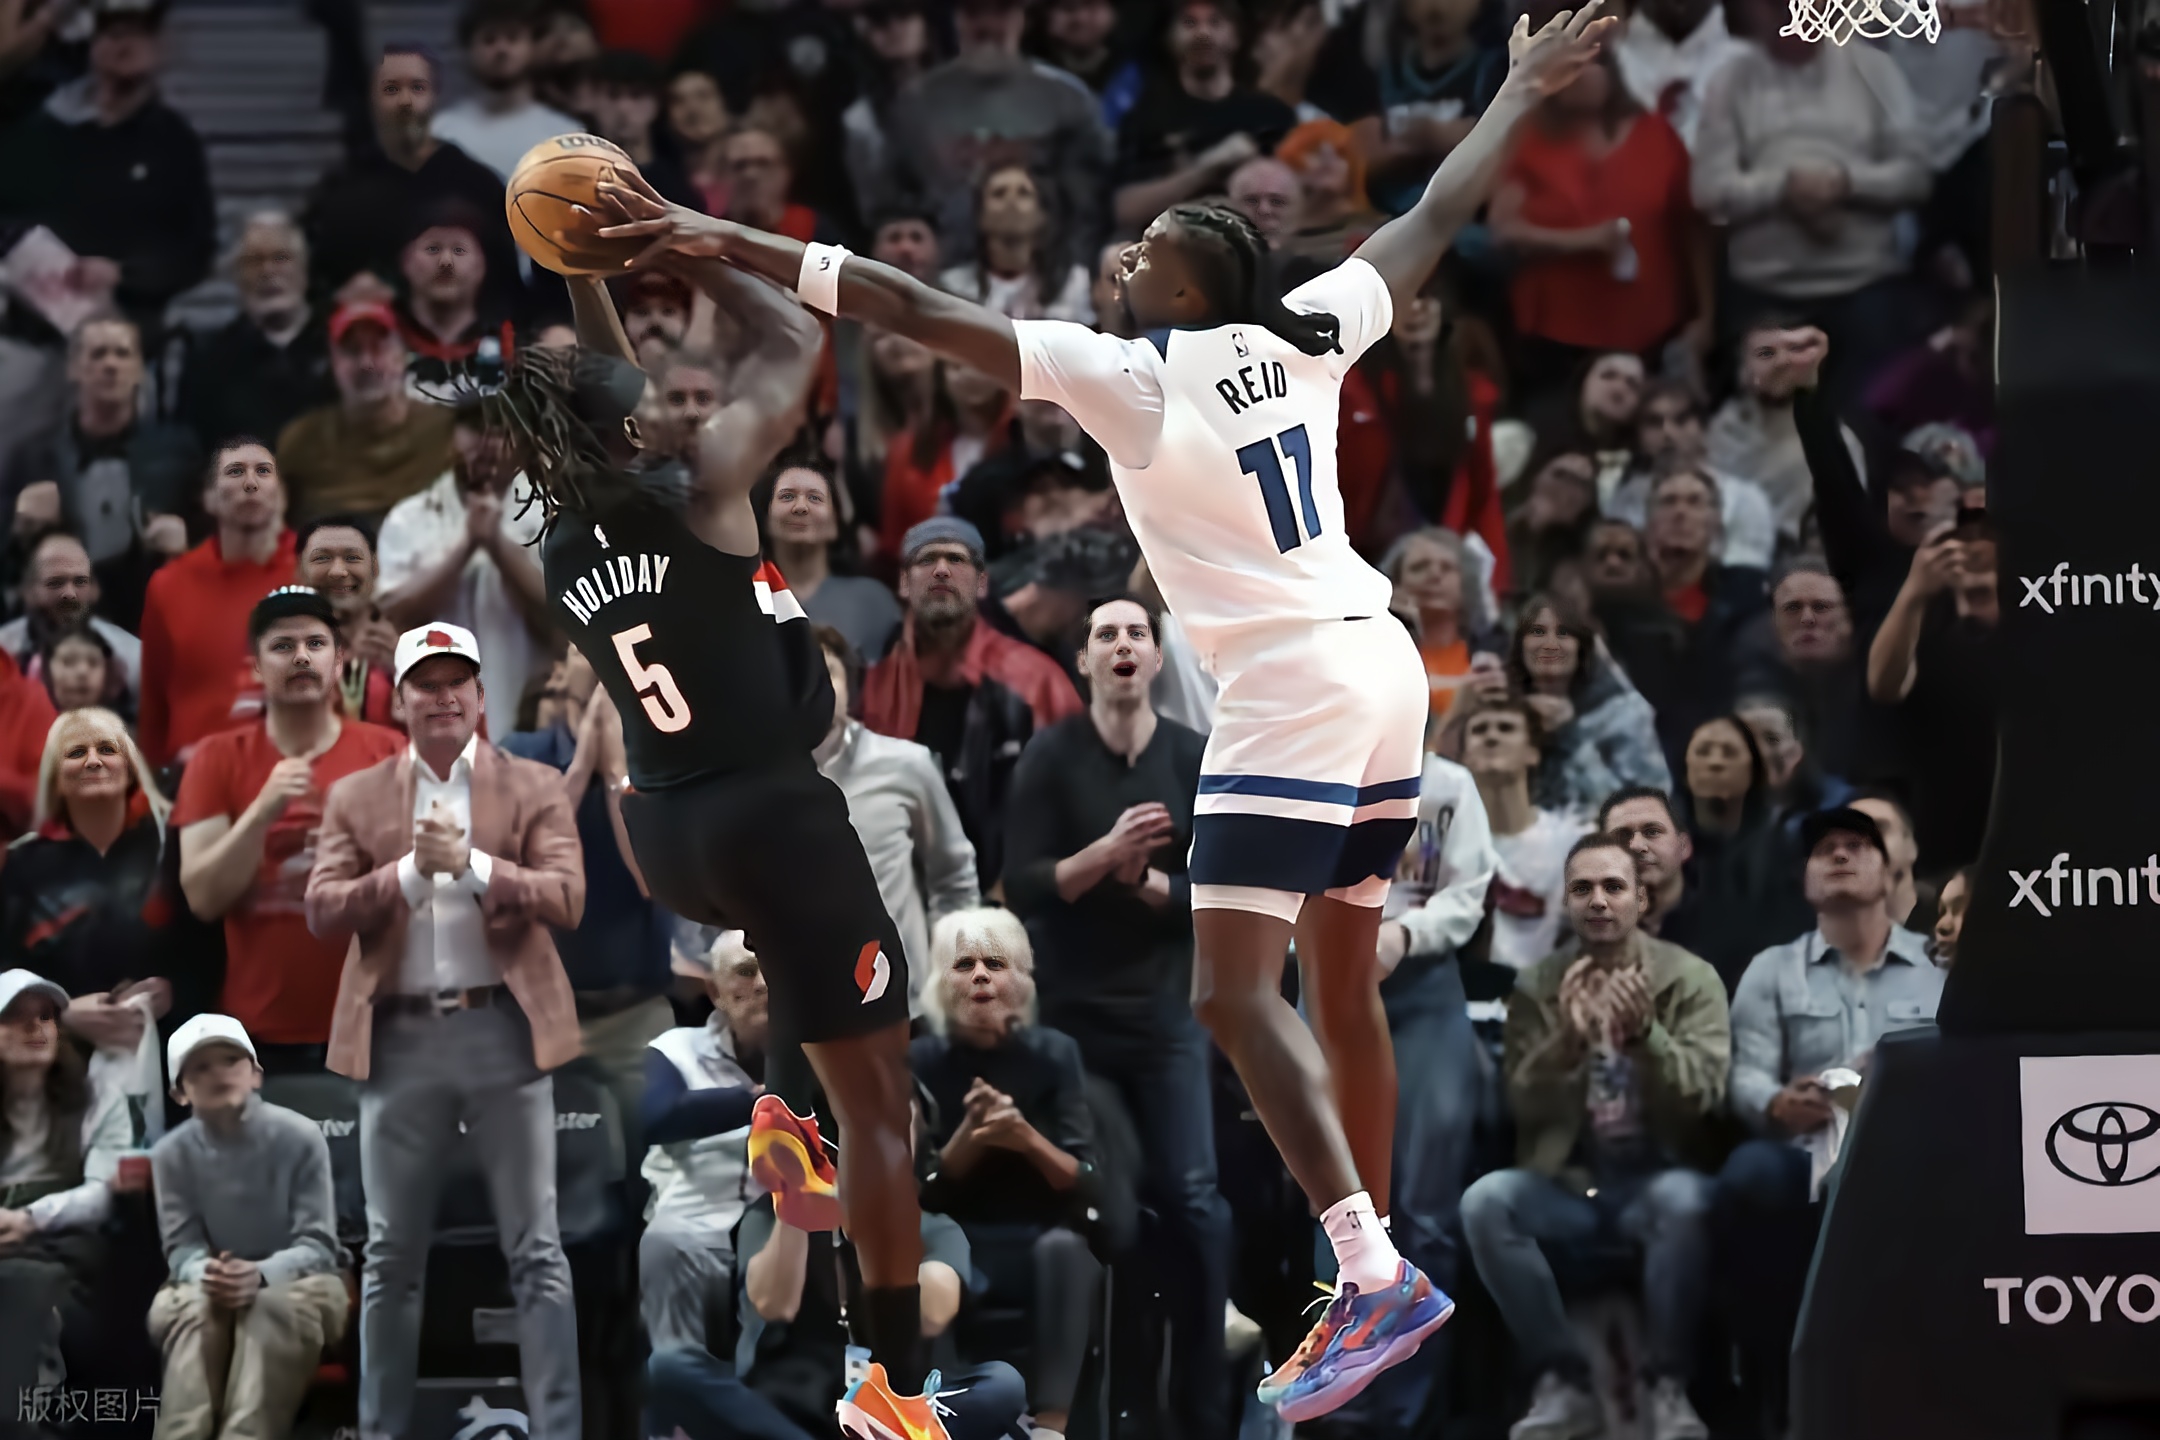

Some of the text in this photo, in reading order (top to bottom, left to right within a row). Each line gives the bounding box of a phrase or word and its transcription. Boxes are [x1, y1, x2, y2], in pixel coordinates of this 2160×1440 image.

[1215, 361, 1287, 415] REID
[1235, 423, 1322, 554] 11
[561, 553, 670, 626] HOLIDAY
[611, 622, 691, 733] 5
[1983, 1273, 2160, 1325] TOYO
